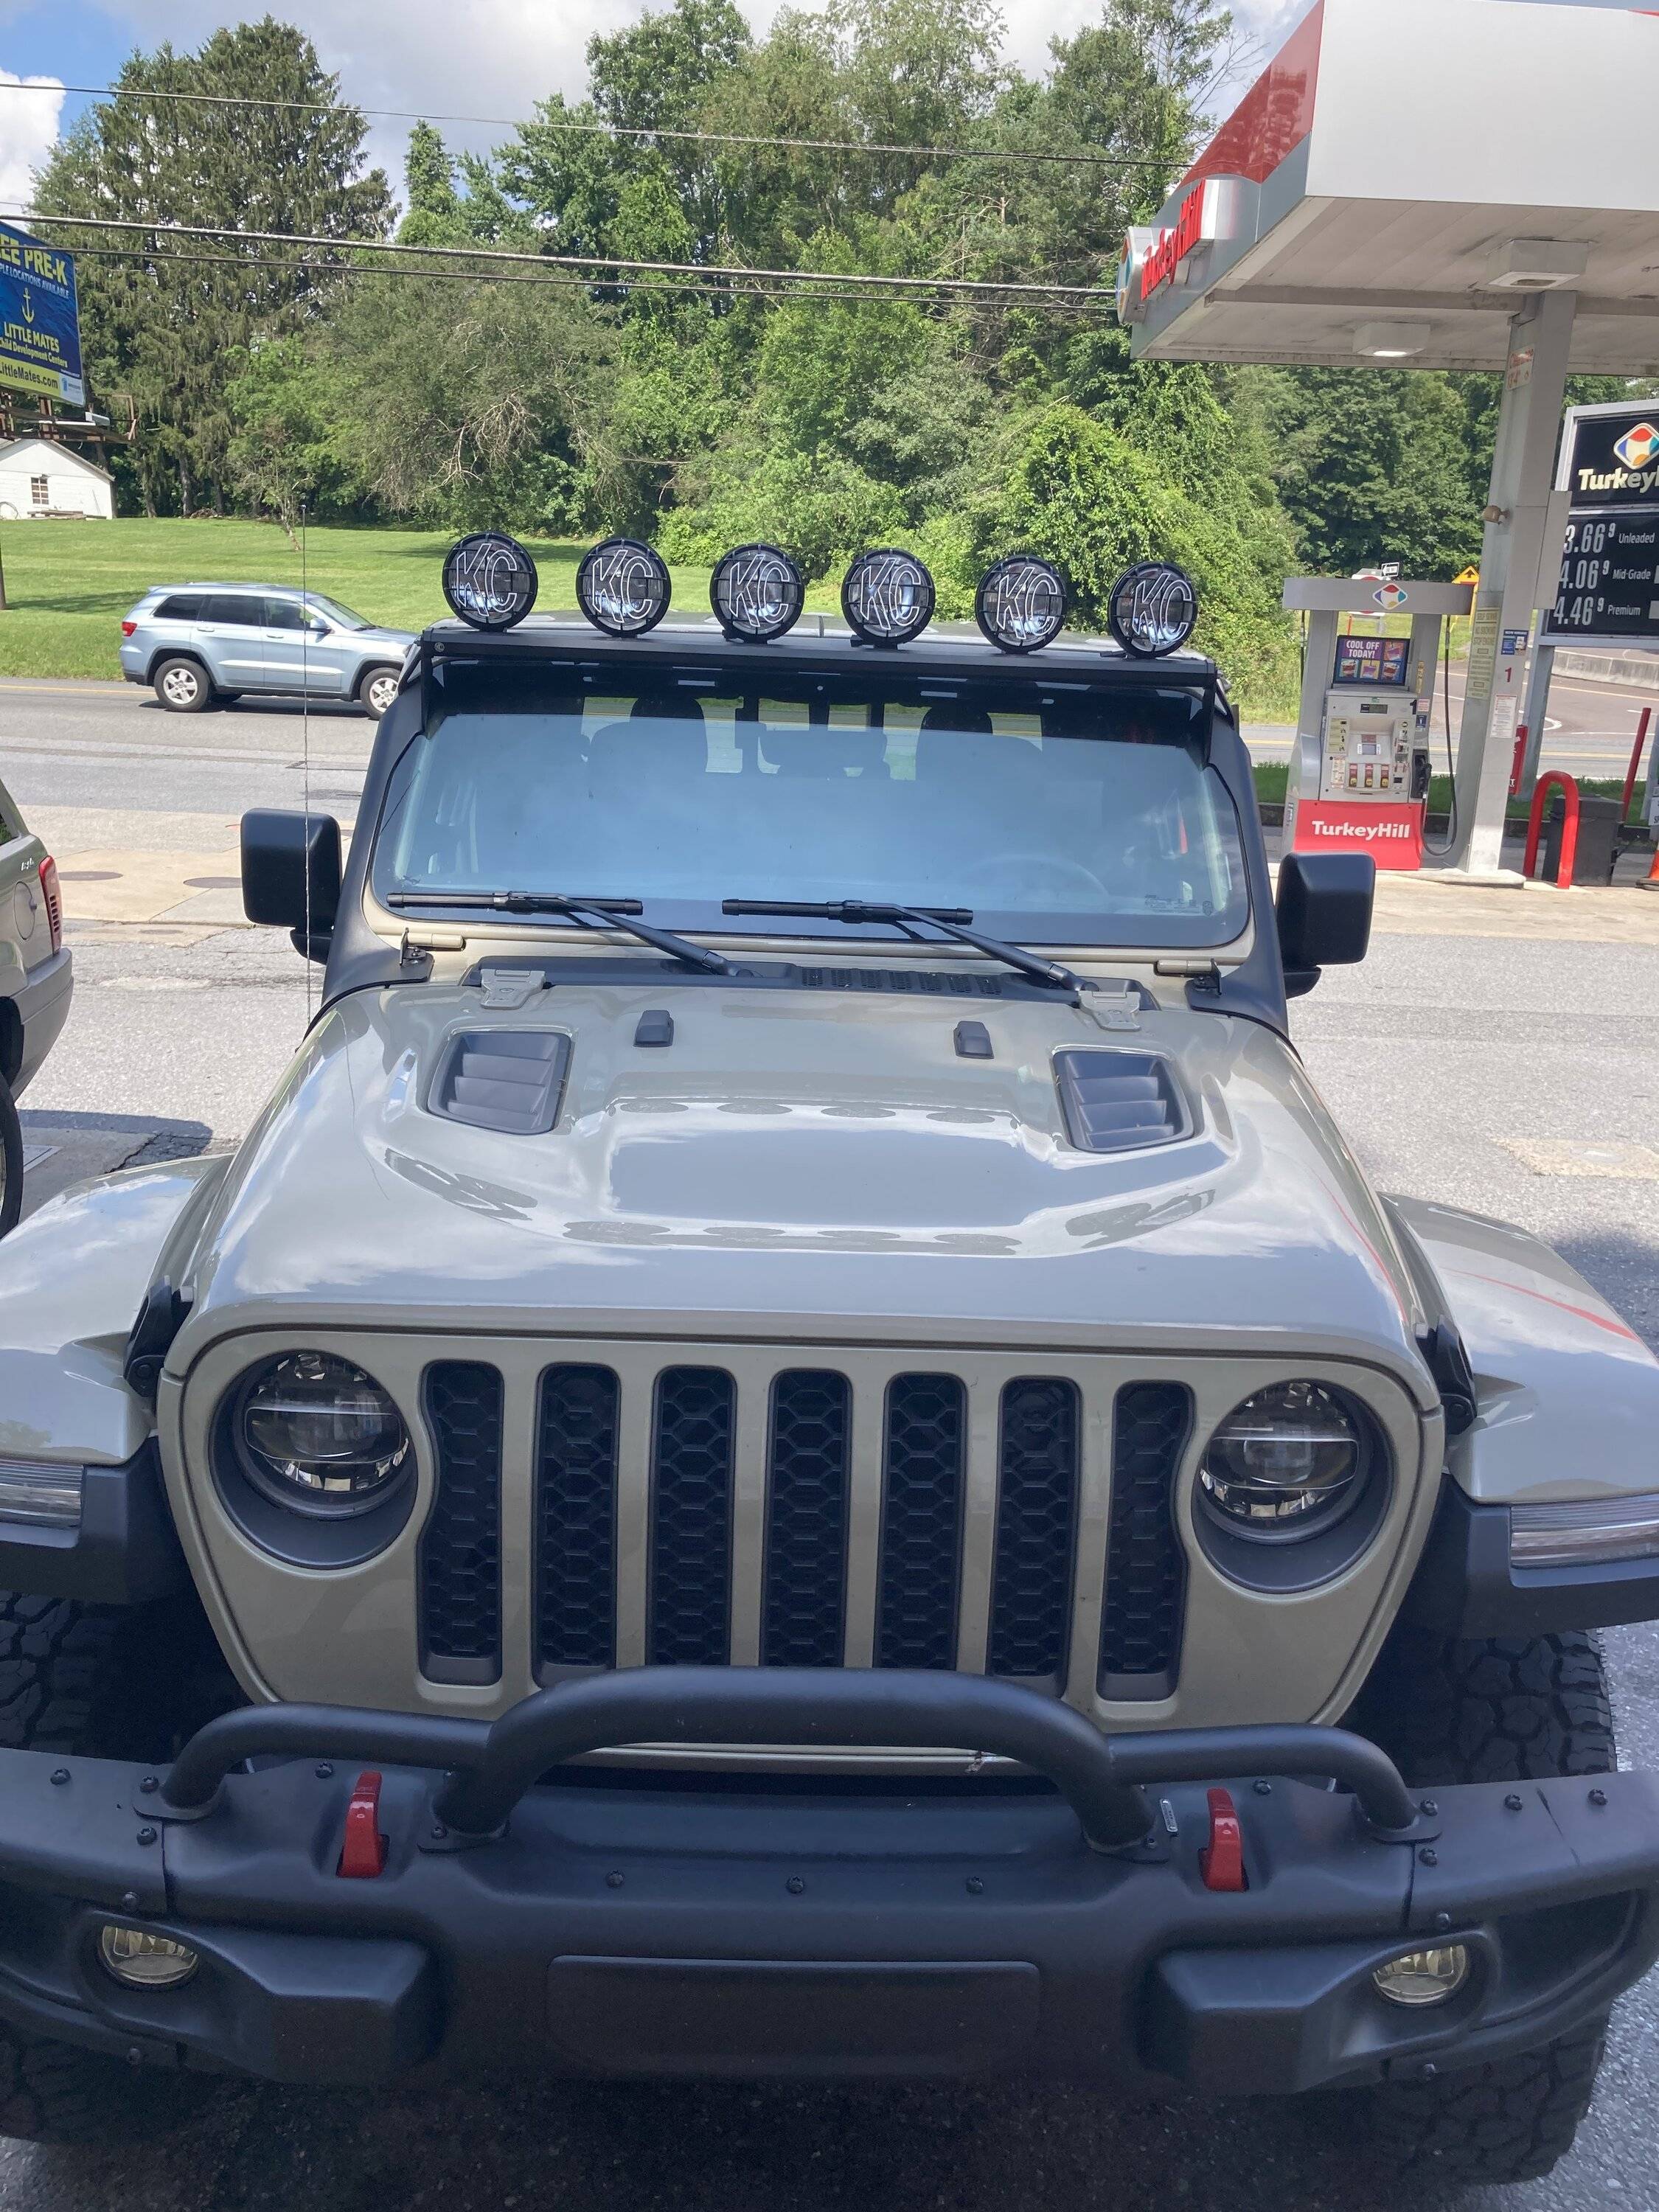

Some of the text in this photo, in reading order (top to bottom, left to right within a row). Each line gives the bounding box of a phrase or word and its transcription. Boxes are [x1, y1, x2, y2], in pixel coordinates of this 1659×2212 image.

[0, 233, 68, 286] EE PRE-K
[10, 266, 41, 288] LOCATIONS
[42, 280, 69, 299] AVAILABLE
[4, 321, 59, 353] LITTLE MATES
[13, 341, 48, 359] Development
[48, 352, 68, 368] Centers
[1578, 465, 1659, 493] Turkey
[1618, 532, 1655, 544] Unleaded
[456, 543, 517, 617] KC
[591, 550, 653, 623] KC
[1613, 568, 1652, 580] Mid-Grade
[729, 554, 790, 627] KC
[860, 557, 922, 630] KC
[995, 566, 1057, 640] KC
[1132, 573, 1192, 645] KC
[1607, 605, 1641, 616] Premium
[1346, 640, 1380, 650] COOL OFF
[1349, 649, 1376, 658] TODAY!
[1505, 667, 1512, 683] 1
[1409, 699, 1417, 715] 1
[1311, 820, 1411, 841] TurkeyHill
